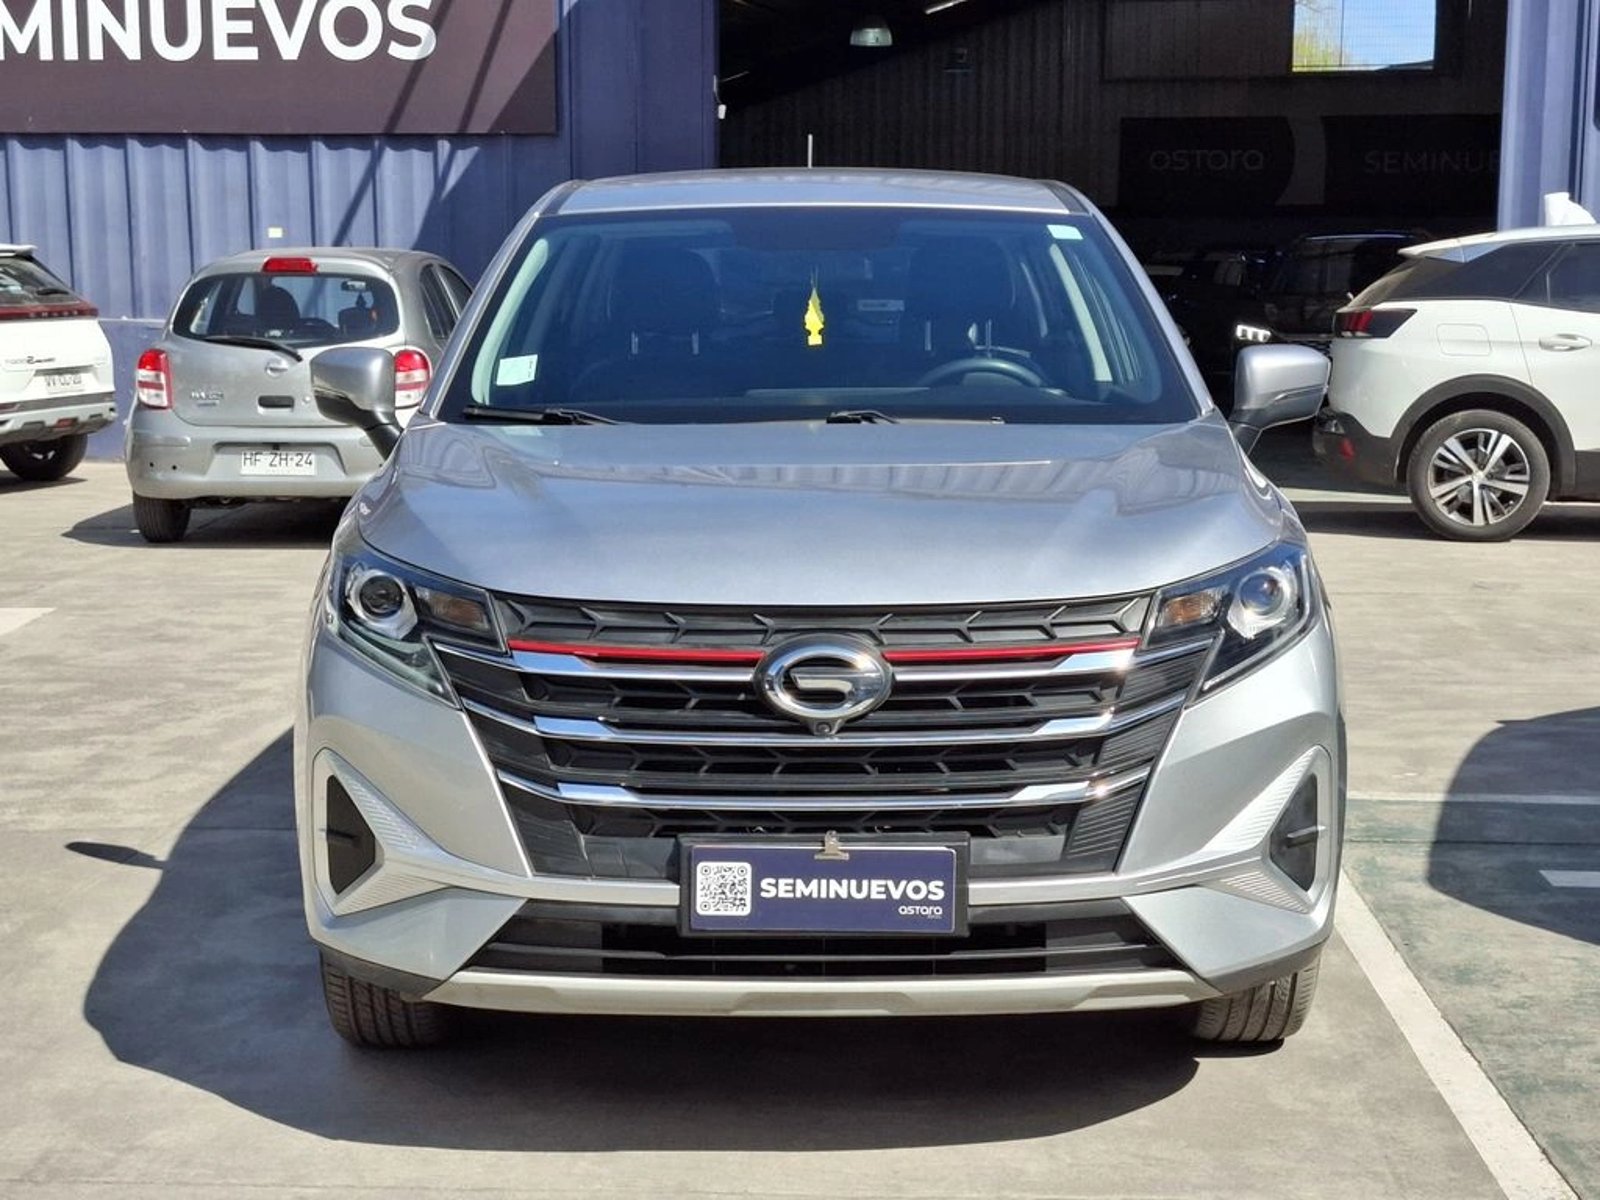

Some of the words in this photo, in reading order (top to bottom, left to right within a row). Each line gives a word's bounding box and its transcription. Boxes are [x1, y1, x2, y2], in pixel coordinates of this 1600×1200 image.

[0, 0, 437, 62] MINUEVOS
[1149, 149, 1265, 171] astara
[760, 877, 945, 900] SEMINUEVOS
[898, 905, 943, 915] astara
